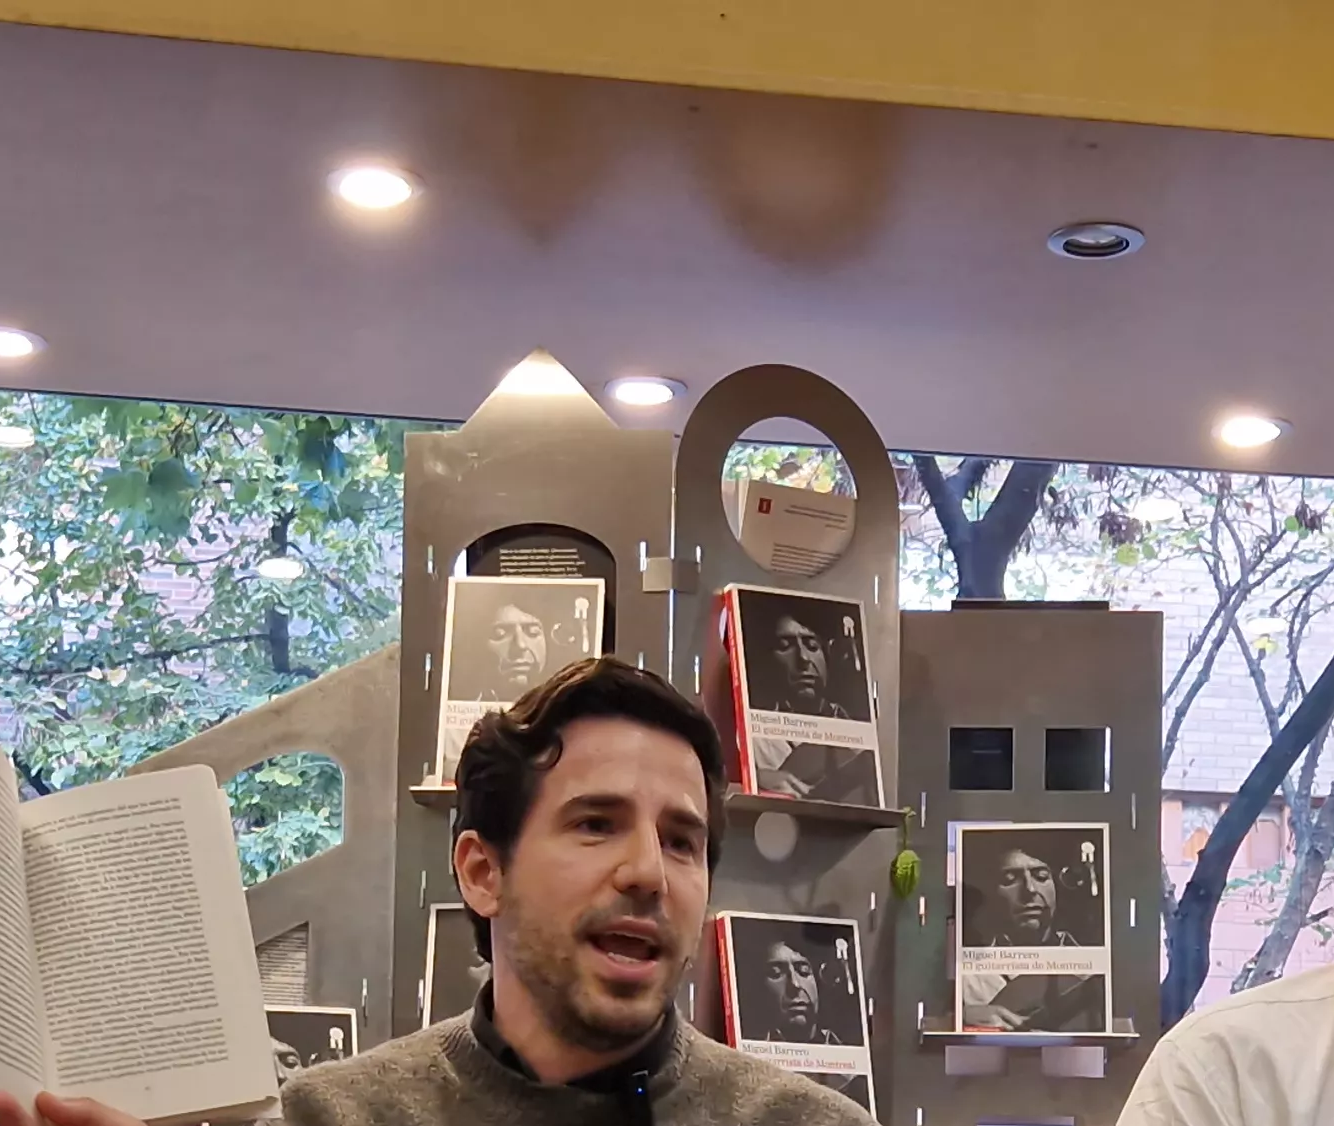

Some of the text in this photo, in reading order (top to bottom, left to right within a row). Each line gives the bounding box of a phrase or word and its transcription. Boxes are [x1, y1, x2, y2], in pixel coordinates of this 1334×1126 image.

[750, 713, 818, 728] Miguel Barrero
[962, 950, 1040, 961] Miguel Barrero
[1046, 961, 1093, 970] Montreal
[742, 1043, 772, 1055] Miguel
